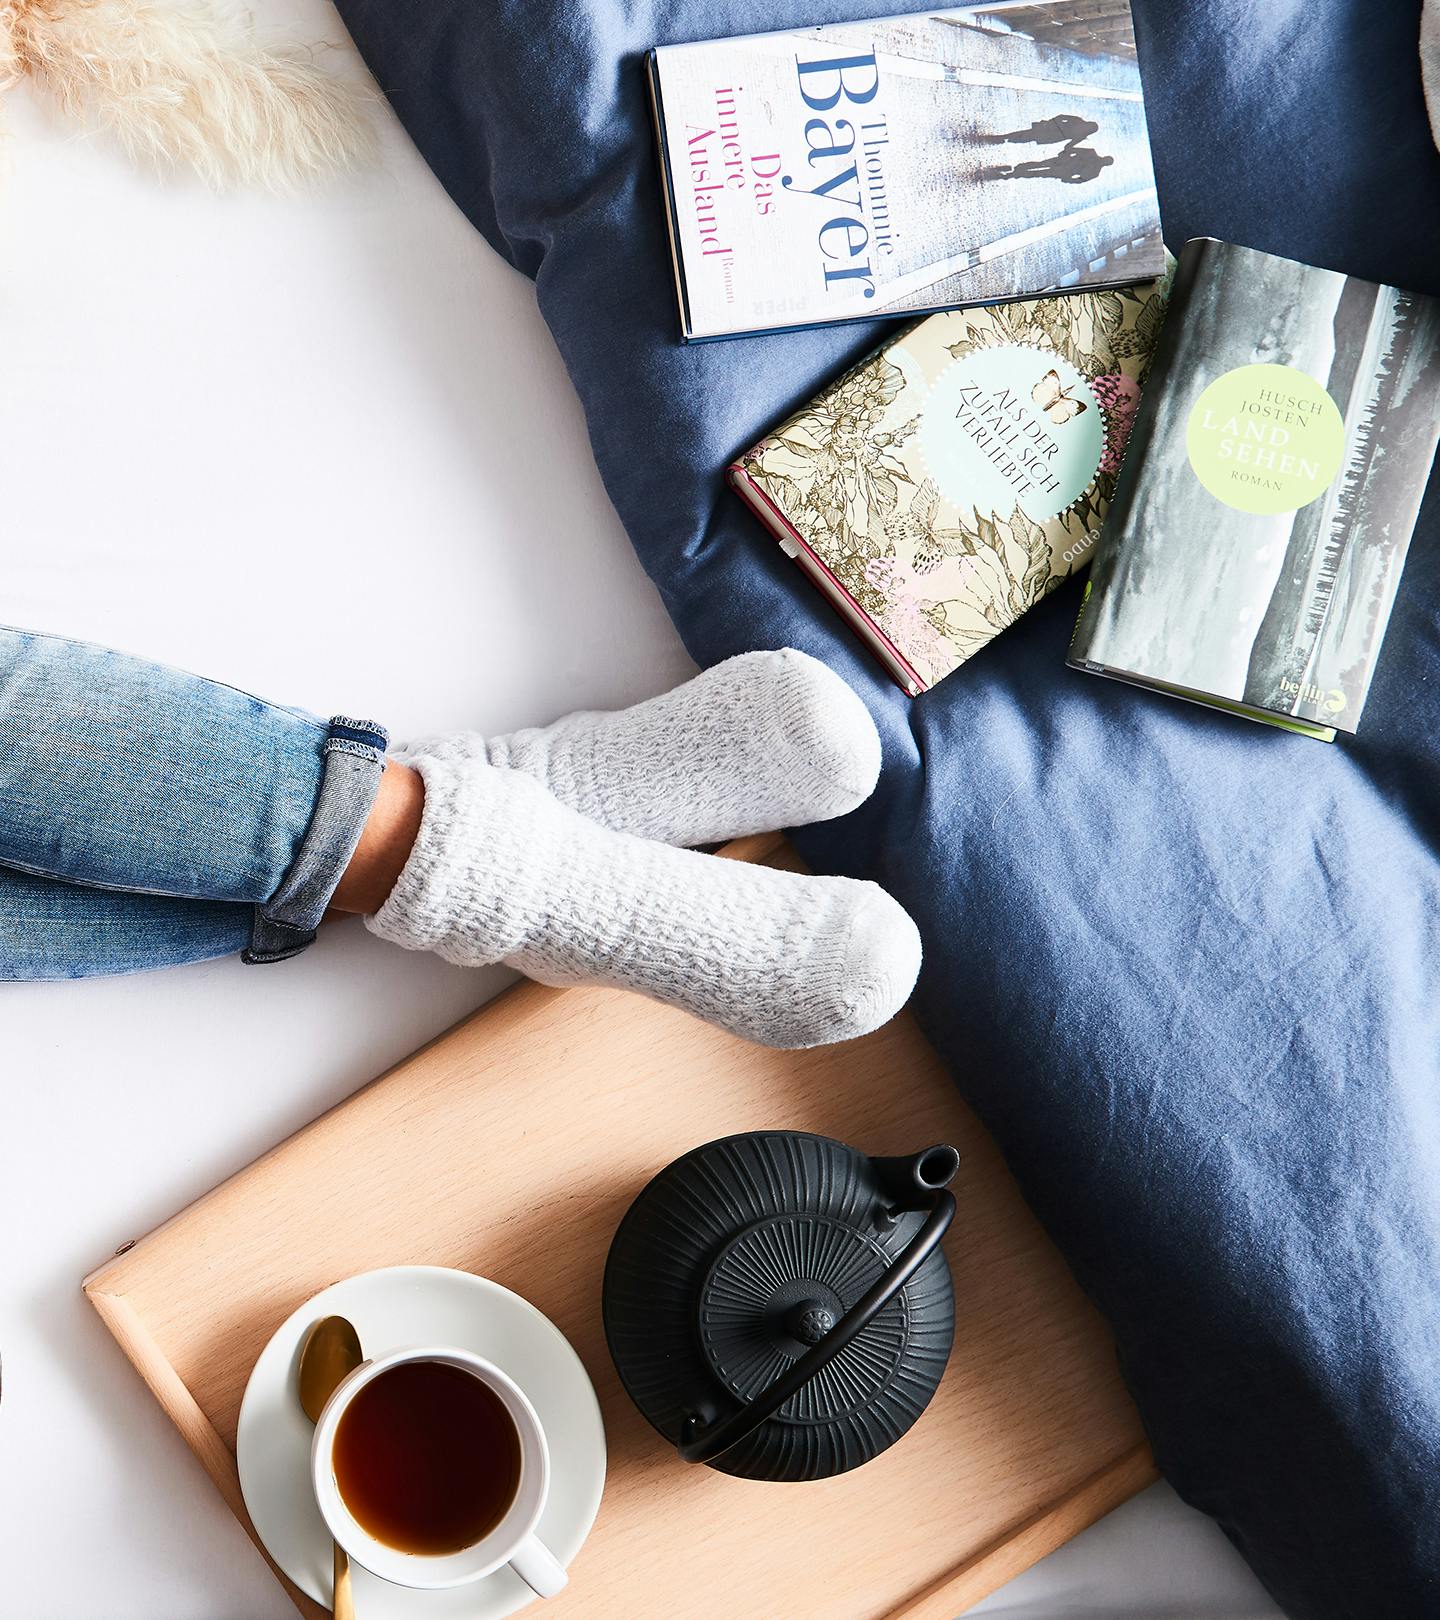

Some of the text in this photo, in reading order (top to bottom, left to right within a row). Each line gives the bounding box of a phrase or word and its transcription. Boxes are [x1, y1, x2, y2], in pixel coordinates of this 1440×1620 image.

[715, 86, 746, 190] innere
[781, 43, 879, 299] Bayer
[686, 123, 735, 304] Ausland Roman
[751, 153, 782, 215] Das
[861, 114, 900, 256] Thommie
[959, 379, 1061, 493] ZUFALL SICH
[993, 388, 1059, 461] ALS DER
[1201, 409, 1291, 447] LAND
[1239, 400, 1309, 427] JOSTEN
[1259, 389, 1323, 415] HUSCH
[955, 403, 1035, 498] VERLIEBTE
[1217, 438, 1321, 481] SEHEN
[1231, 470, 1283, 491] ROMAN
